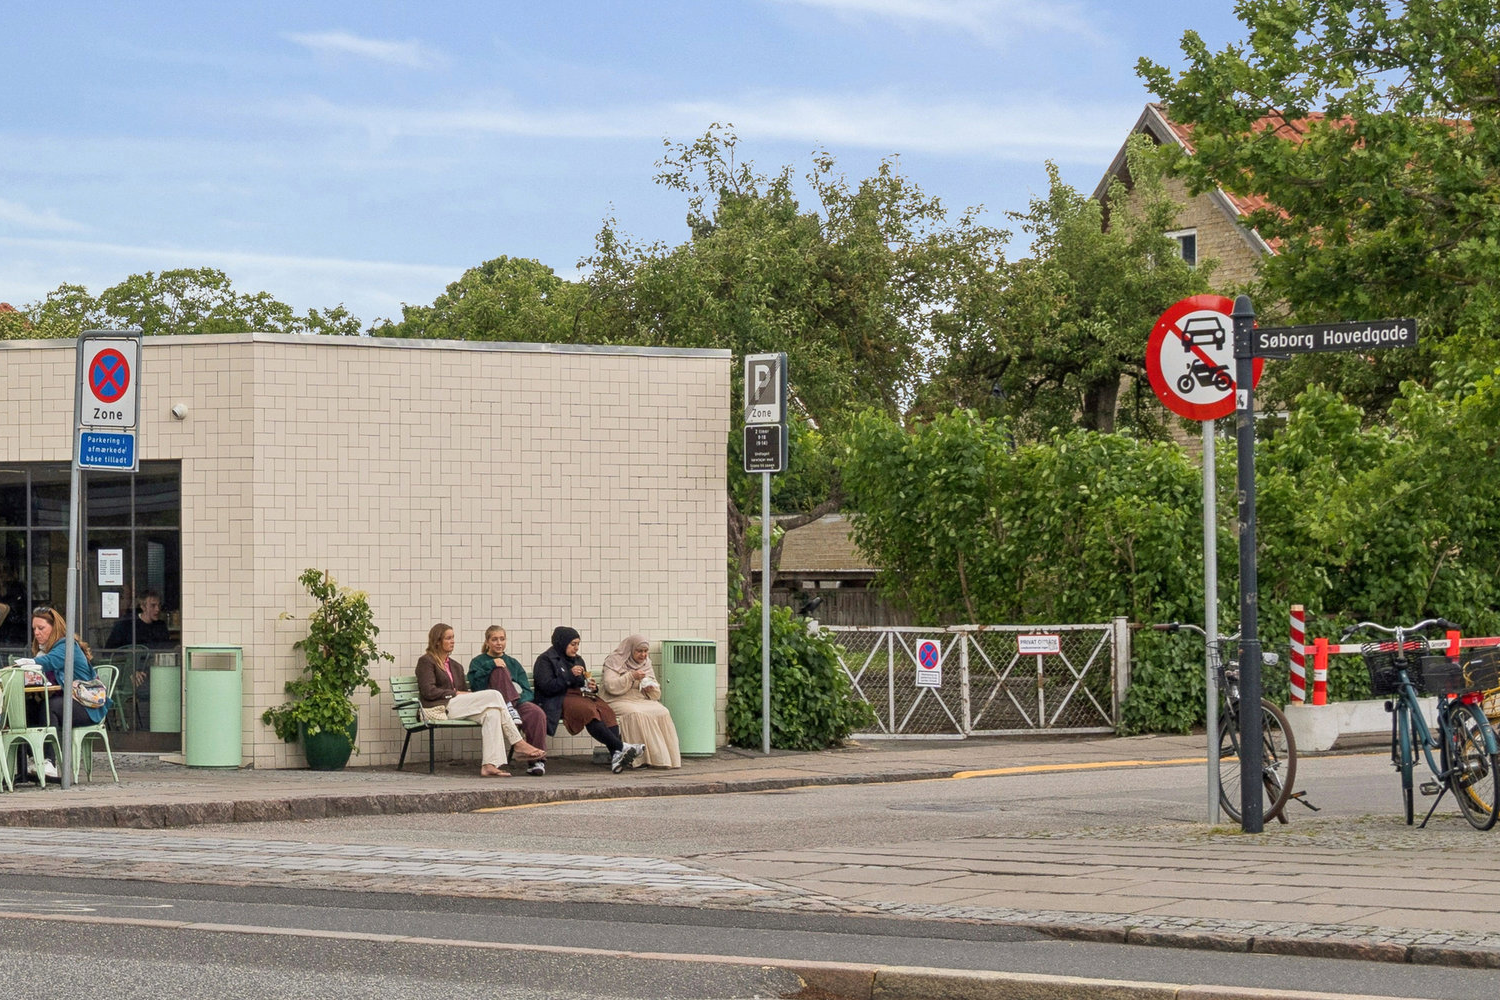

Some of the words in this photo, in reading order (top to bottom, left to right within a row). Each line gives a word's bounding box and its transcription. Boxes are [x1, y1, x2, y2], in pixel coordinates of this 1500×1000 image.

[1259, 333, 1314, 349] Søborg
[1323, 325, 1408, 345] Hovedgade
[93, 407, 123, 420] Zone
[751, 408, 772, 418] Zone
[87, 436, 120, 445] Parkering
[87, 446, 126, 454] afmærkede
[85, 455, 102, 463] båse
[104, 456, 127, 464] tilladt
